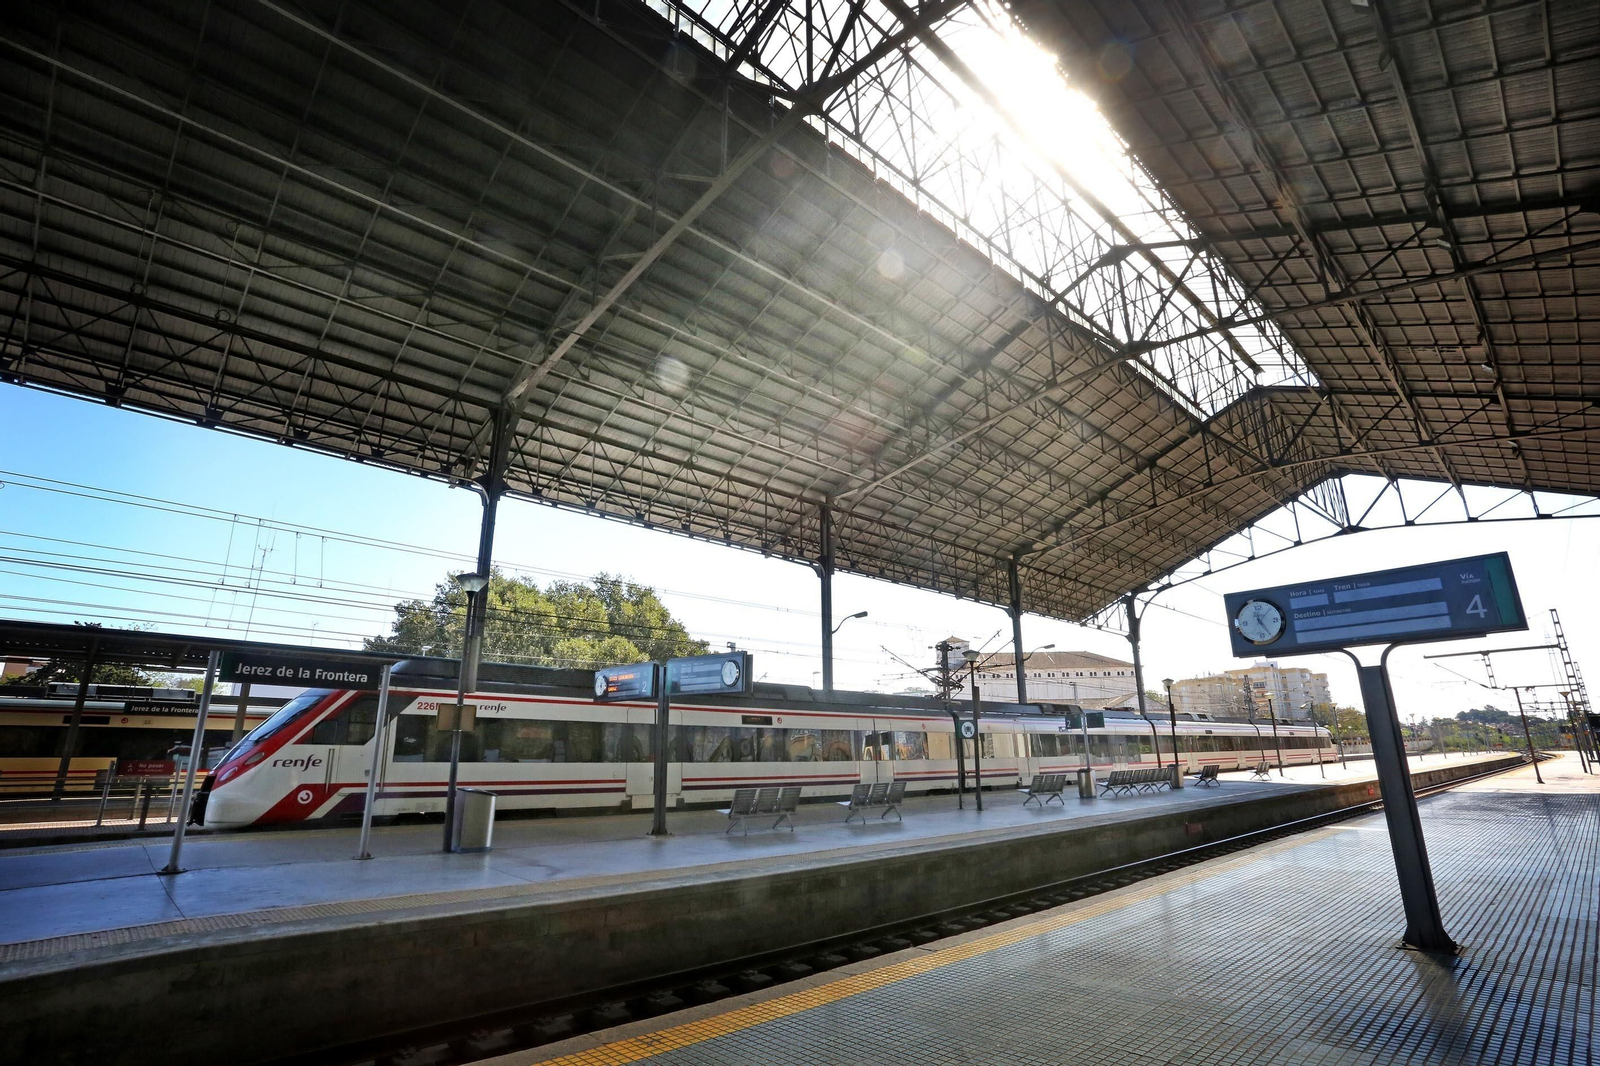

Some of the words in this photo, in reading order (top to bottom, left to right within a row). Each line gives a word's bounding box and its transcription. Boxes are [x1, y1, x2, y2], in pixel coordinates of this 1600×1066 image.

[1465, 594, 1488, 619] 4
[1293, 610, 1321, 619] Destino
[235, 662, 272, 676] Jerez
[276, 665, 294, 678] de
[298, 667, 310, 679] la
[315, 668, 368, 683] Frontera
[641, 681, 648, 693] 2
[170, 706, 199, 714] Frontera
[479, 702, 507, 714] renfe
[1066, 720, 1071, 728] 2
[272, 753, 323, 772] renfe
